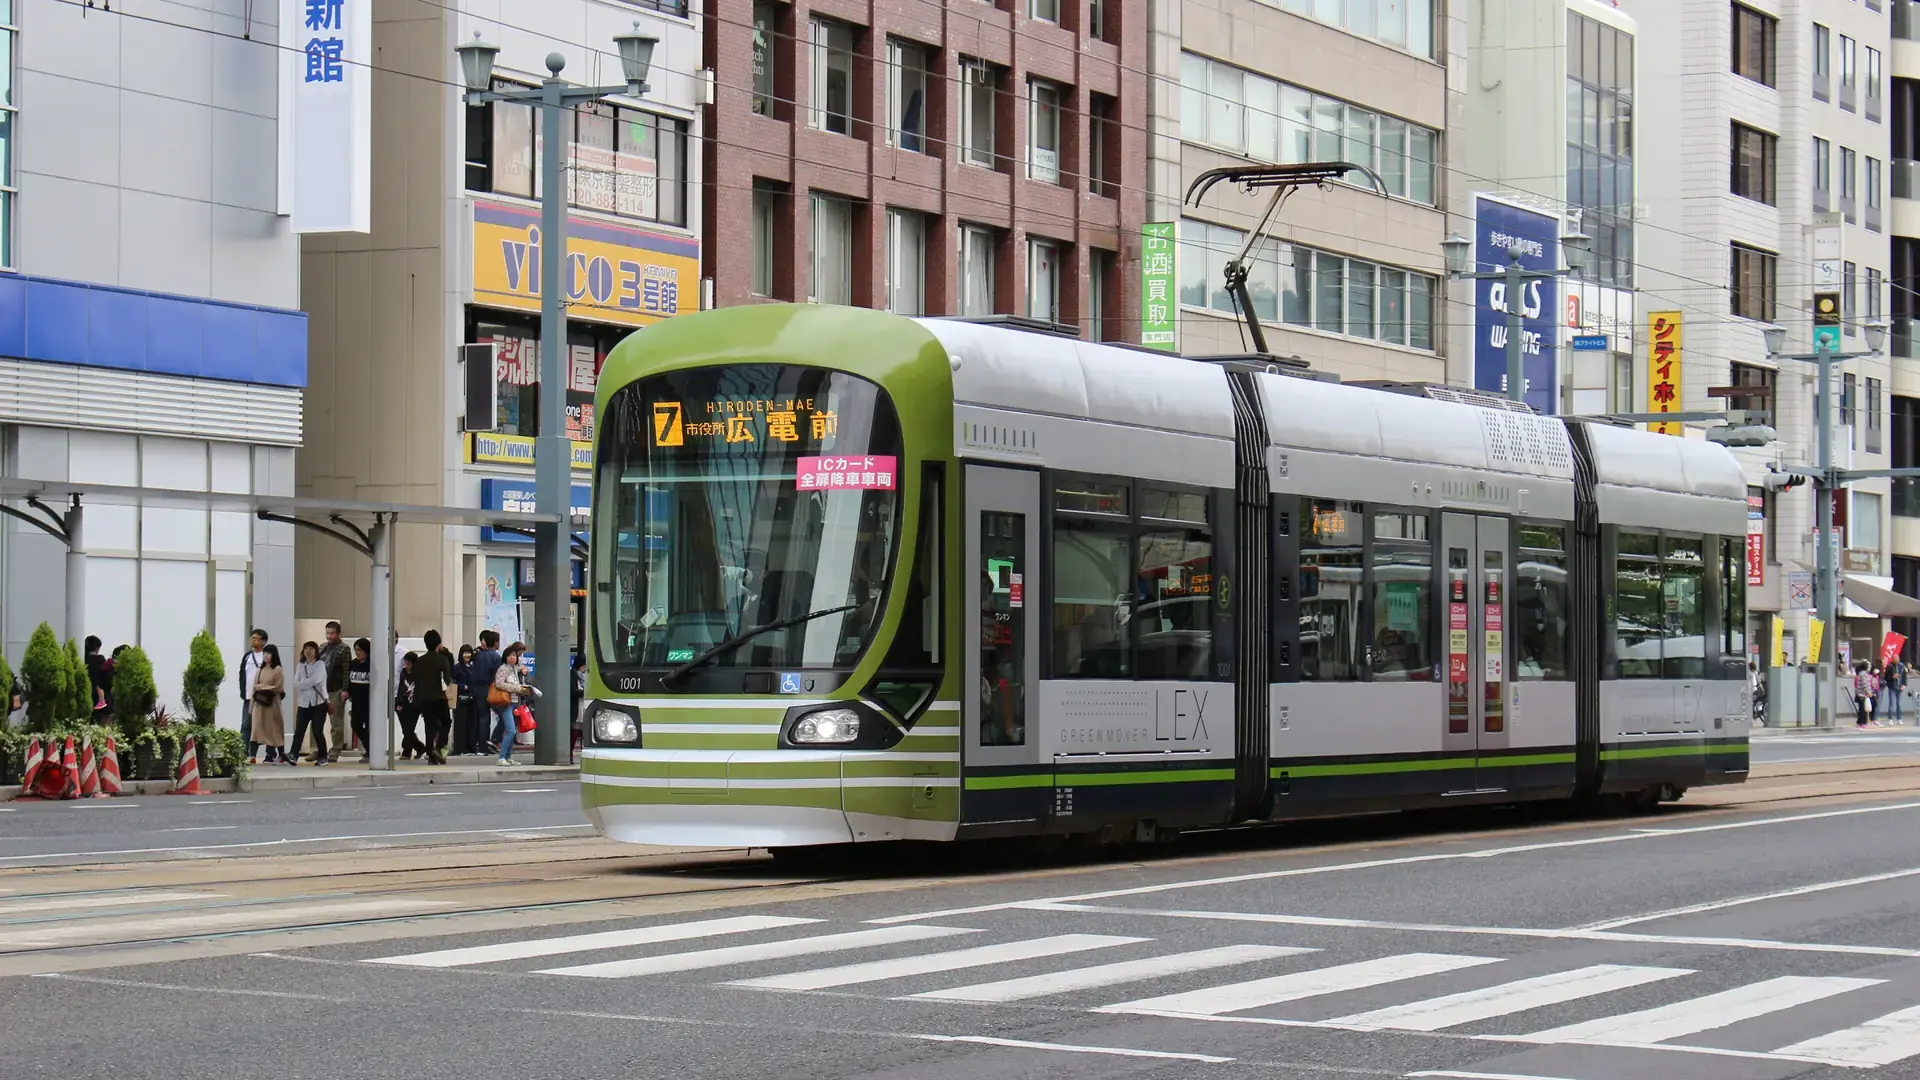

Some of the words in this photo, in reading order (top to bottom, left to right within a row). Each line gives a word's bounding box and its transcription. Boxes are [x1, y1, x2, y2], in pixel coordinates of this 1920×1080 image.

[304, 0, 344, 83] 新館
[643, 264, 677, 280] KAMIYA
[1148, 227, 1168, 325] お酒買取
[706, 398, 815, 413] HIRODEN-MAE
[655, 404, 680, 443] 7
[685, 422, 725, 437] 市役所
[725, 413, 838, 443] 広電前
[817, 457, 875, 471] ICカード
[800, 472, 893, 488] 全扉降車車両
[668, 651, 694, 660] ワンマン
[619, 677, 641, 690] 1001
[1155, 689, 1209, 741] LEX
